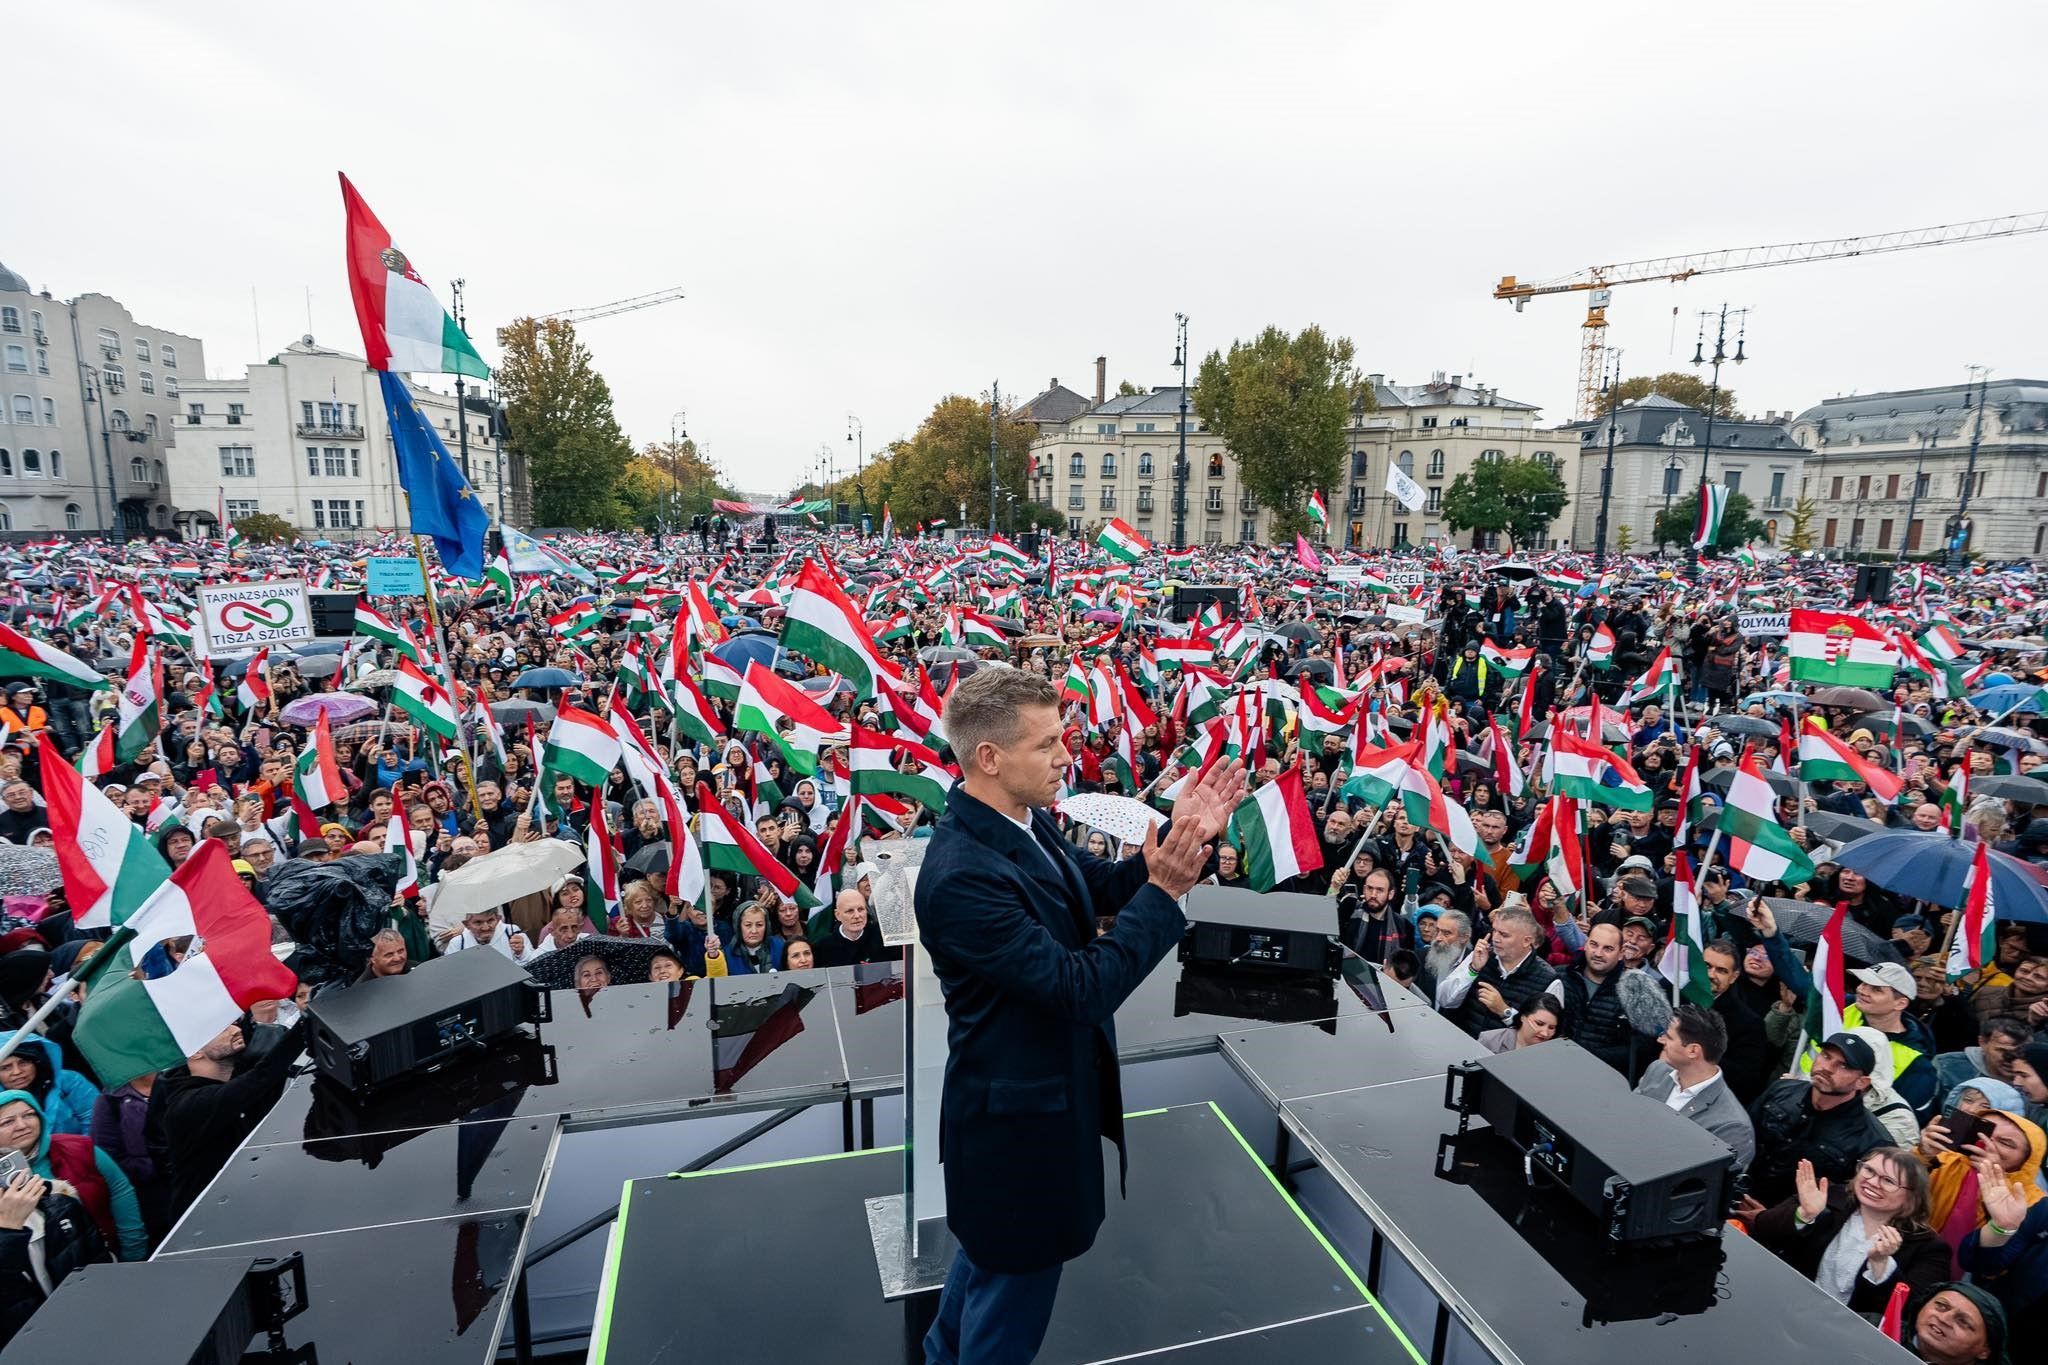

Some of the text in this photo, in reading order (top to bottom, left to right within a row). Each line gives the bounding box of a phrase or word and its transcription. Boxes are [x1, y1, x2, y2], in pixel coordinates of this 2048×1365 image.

[1385, 573, 1421, 585] PÉCEL
[205, 587, 300, 604] TARNAZSADÁNY
[212, 626, 307, 645] TISZA SZIGET
